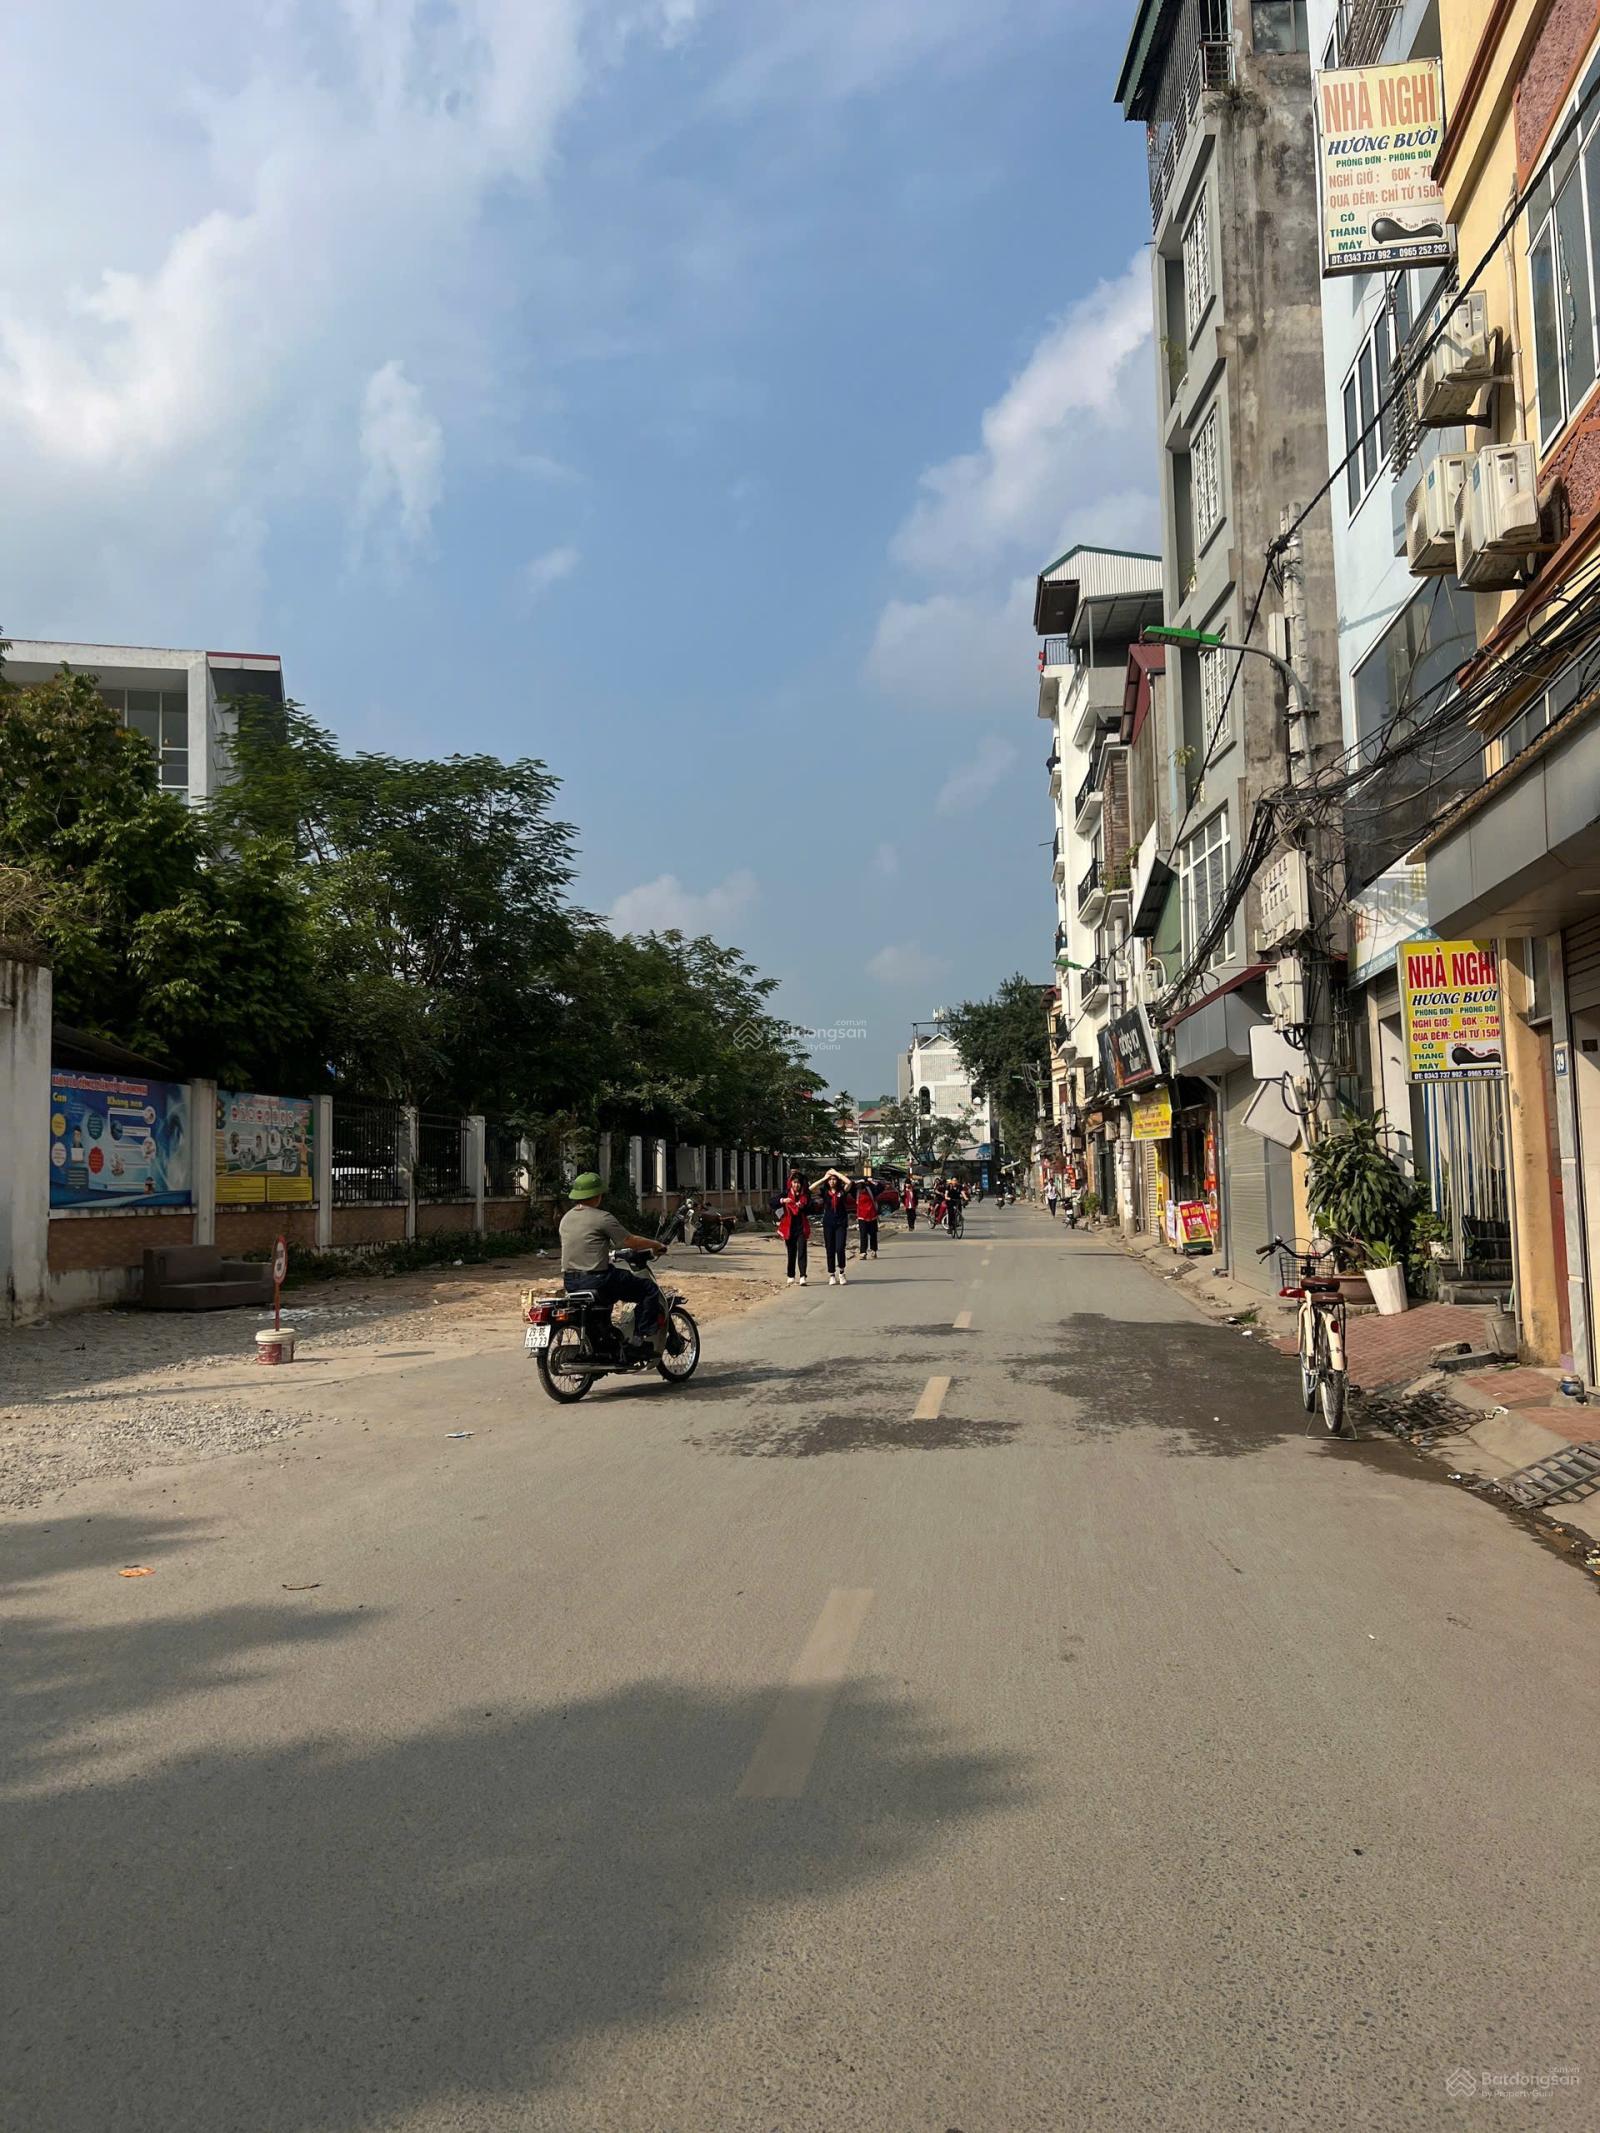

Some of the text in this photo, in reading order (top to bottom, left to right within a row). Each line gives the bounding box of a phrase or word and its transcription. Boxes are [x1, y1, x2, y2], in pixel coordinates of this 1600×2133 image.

[1323, 62, 1437, 133] NHÀ NGHỈ
[1328, 126, 1438, 155] HƯƠNG BƯỞI
[1336, 157, 1363, 168] PHÒNG
[1365, 155, 1382, 165] ĐƠN
[1389, 152, 1416, 162] PHÒNG
[1418, 149, 1432, 159] ĐÔI
[1391, 167, 1411, 182] 60K
[1330, 193, 1350, 209] QUA
[1352, 190, 1379, 207] ĐÊM:
[1381, 187, 1399, 203] CHỈ
[1340, 211, 1355, 223] CÓ
[1329, 226, 1367, 238] THANG
[1338, 239, 1363, 251] MÁY
[1344, 251, 1362, 264] 0343
[1363, 249, 1376, 261] 737
[1378, 249, 1391, 260] 992
[1399, 246, 1417, 259] 0965
[1418, 244, 1432, 256] 252
[1434, 243, 1448, 254] 292
[1408, 947, 1447, 989] NHÀ
[1412, 987, 1497, 1006] HƯƠNG BƯỞI
[1462, 1017, 1477, 1026] 60K
[1413, 1032, 1428, 1042] QUA
[1414, 1052, 1444, 1060] THANG
[1424, 1071, 1438, 1080] 0343
[1440, 1070, 1450, 1079] 737
